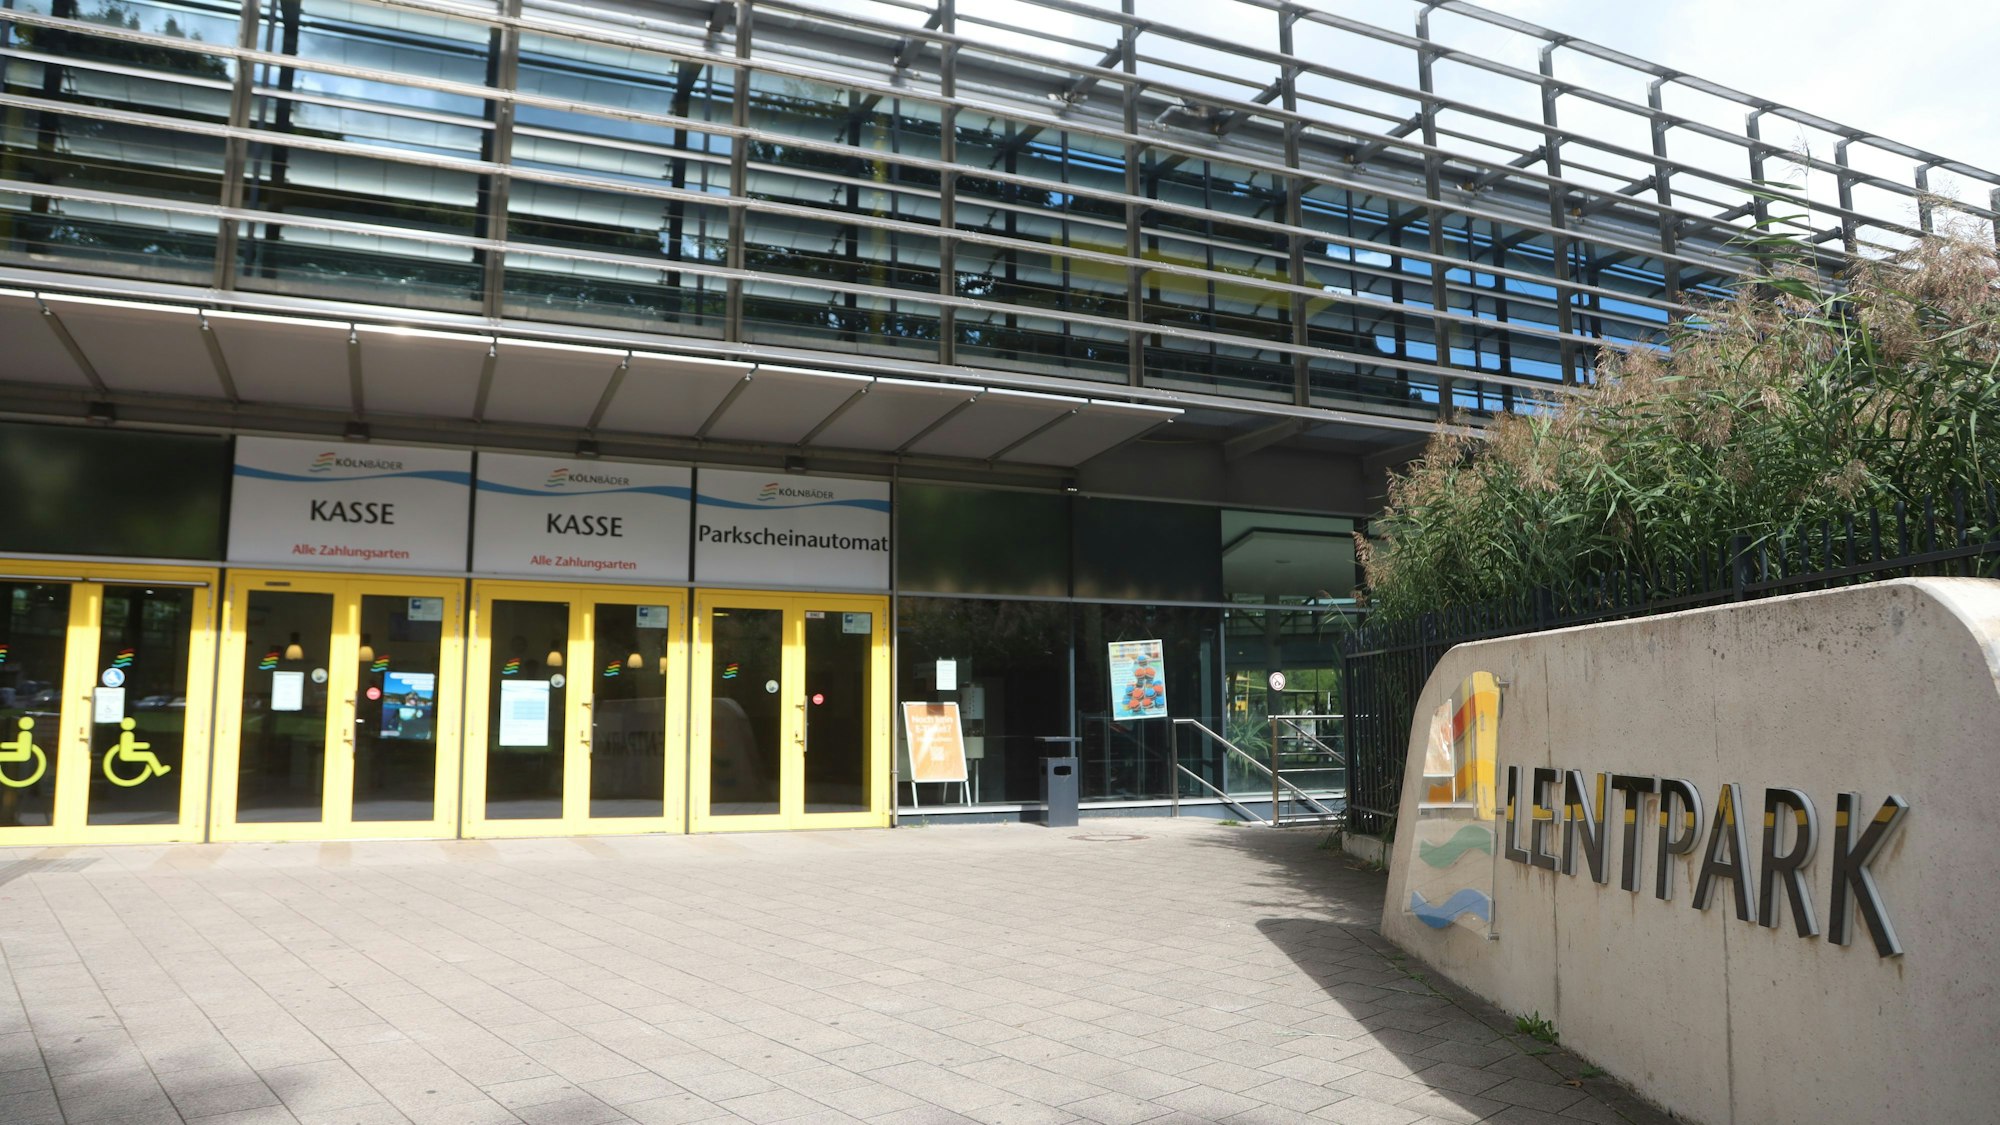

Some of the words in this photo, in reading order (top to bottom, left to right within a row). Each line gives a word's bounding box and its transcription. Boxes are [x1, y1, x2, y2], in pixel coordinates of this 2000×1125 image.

[335, 456, 403, 471] KÖLNBÄDER
[568, 473, 630, 486] KÖLNBÄDER
[778, 486, 834, 500] KÖLNBÄDER
[310, 500, 395, 525] KASSE
[547, 513, 623, 537] KASSE
[699, 525, 889, 552] Parkscheinautomat
[292, 543, 316, 556] Alle
[319, 544, 410, 560] Zahlungsarten
[530, 554, 552, 566] Alle
[555, 556, 637, 571] Zahlungsarten
[1504, 764, 1910, 959] LENTPARK
